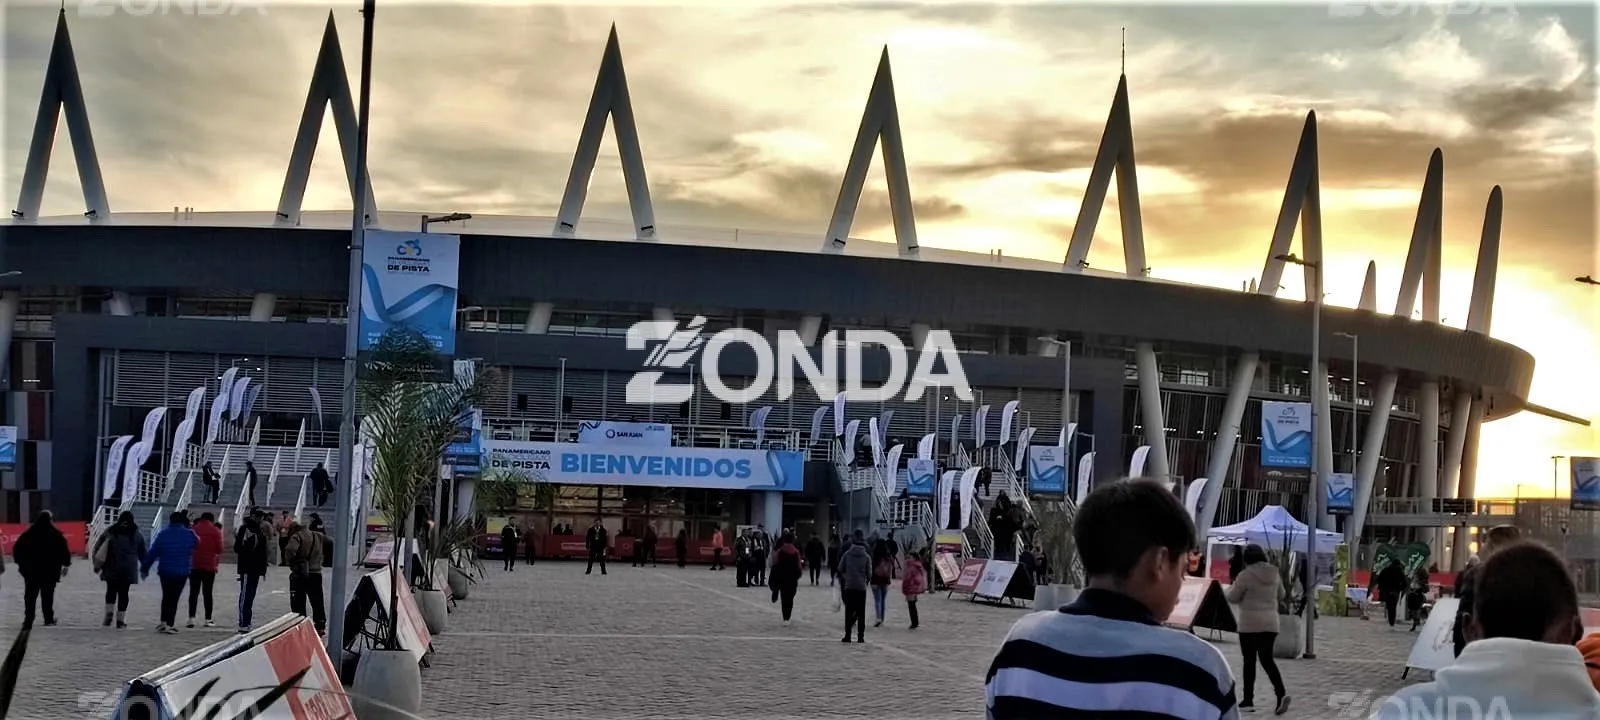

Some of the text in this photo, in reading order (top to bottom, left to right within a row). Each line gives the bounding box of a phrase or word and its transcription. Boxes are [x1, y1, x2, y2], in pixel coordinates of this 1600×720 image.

[492, 460, 551, 470] DE PISTA
[561, 452, 751, 479] BIENVENIDOS
